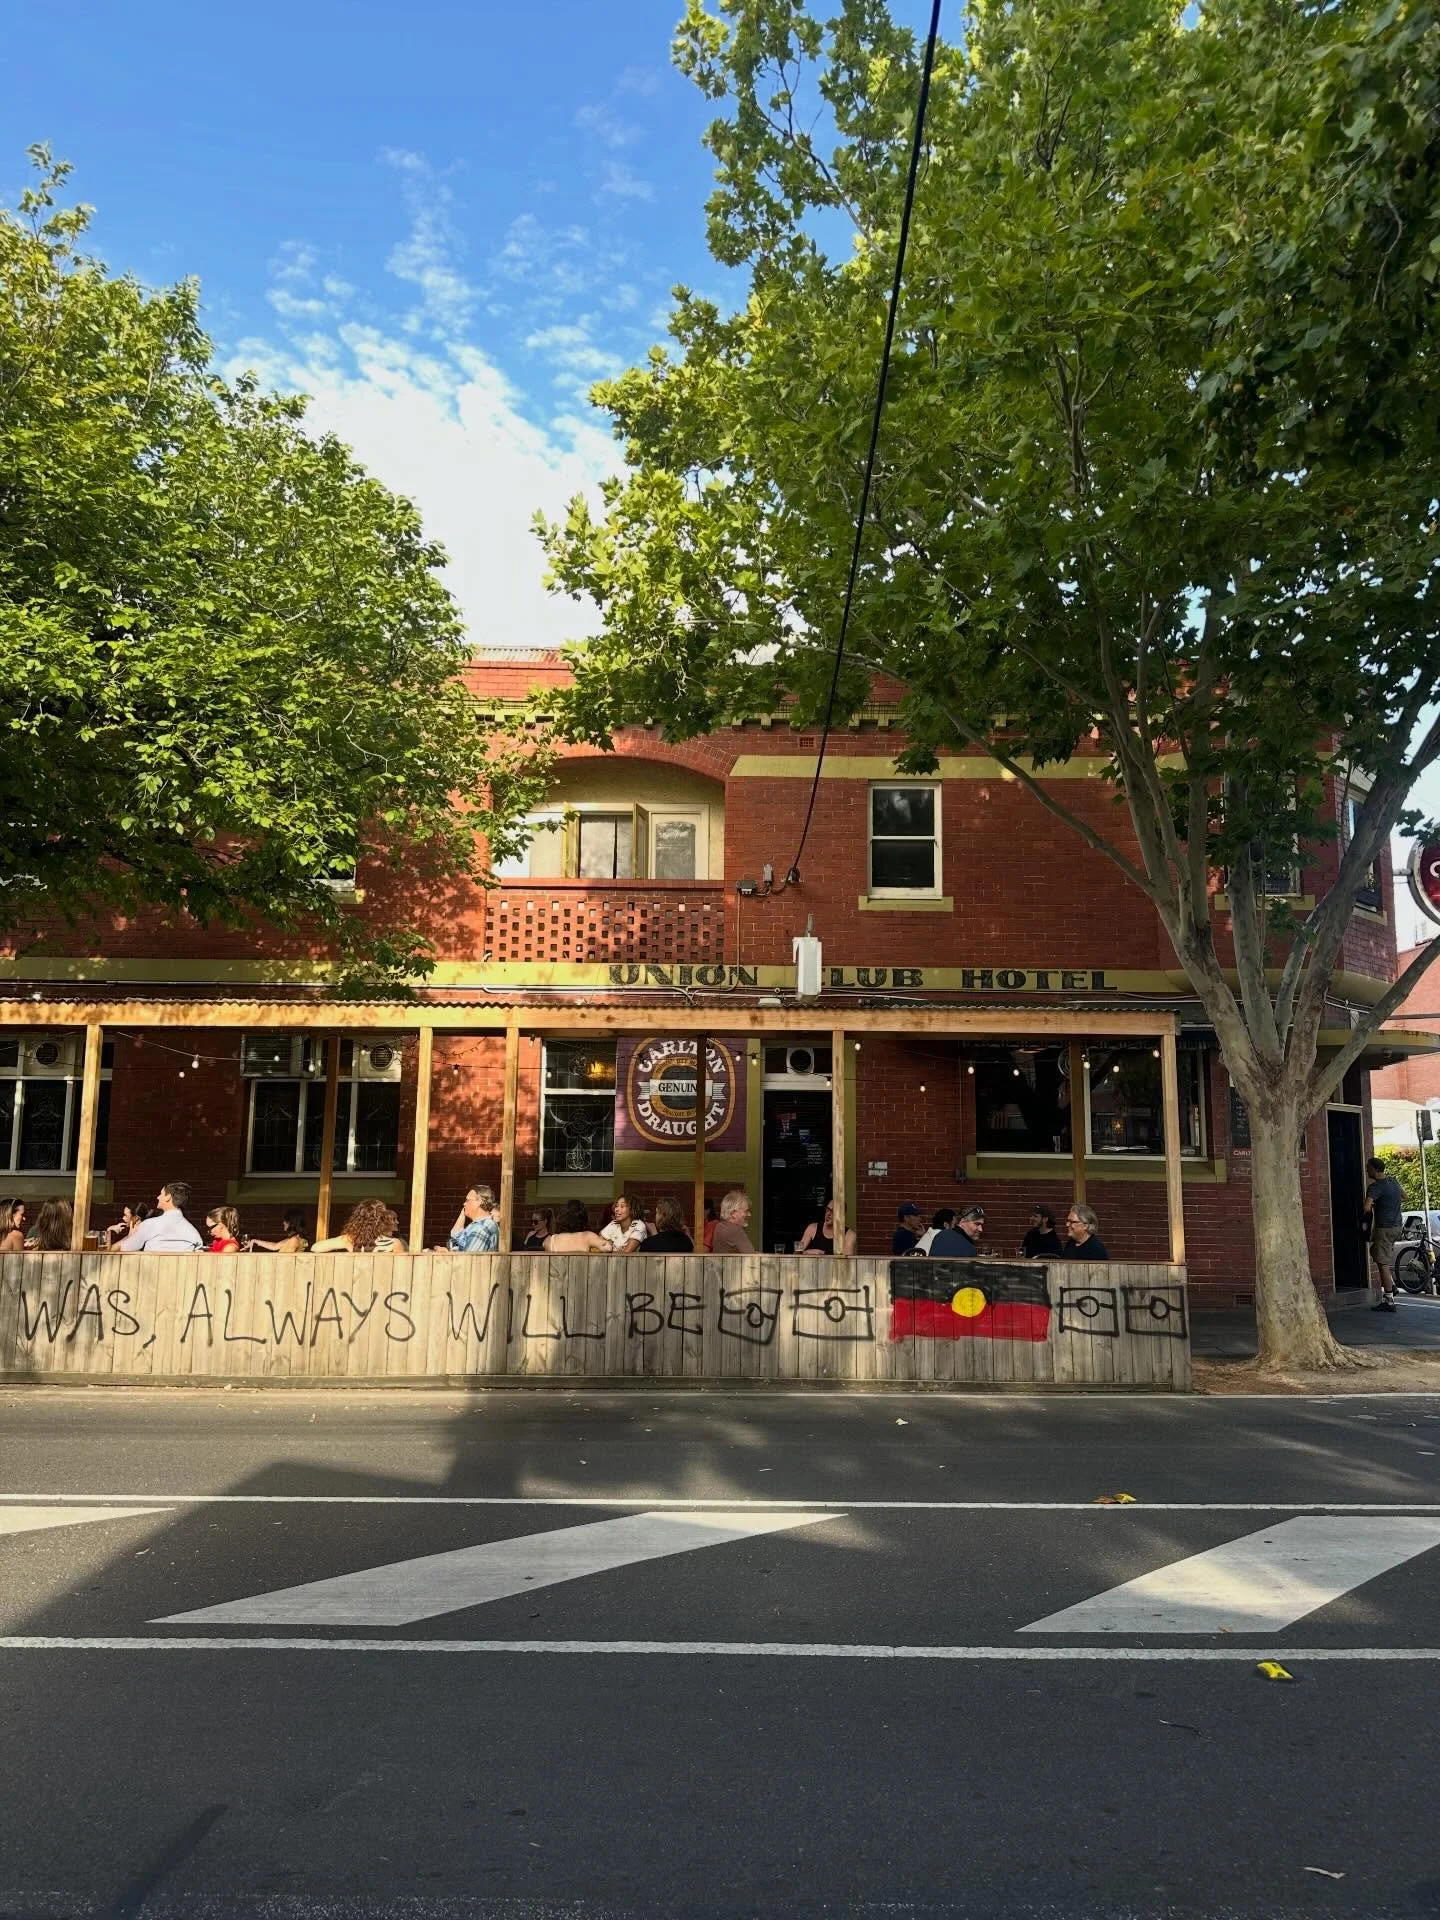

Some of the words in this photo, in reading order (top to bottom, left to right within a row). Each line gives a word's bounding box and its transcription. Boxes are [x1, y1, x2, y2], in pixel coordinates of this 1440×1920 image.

[609, 964, 758, 986] UNION
[821, 967, 923, 988] LUB
[961, 969, 1118, 990] HOTEL
[637, 1040, 726, 1074] CARLTON
[658, 1082, 697, 1093] GENUIN
[637, 1100, 726, 1136] DRAUGHT
[20, 1279, 157, 1349] WAS,
[179, 1281, 417, 1347] ALWAYS
[446, 1282, 605, 1344] WILL
[625, 1291, 706, 1339] BE
